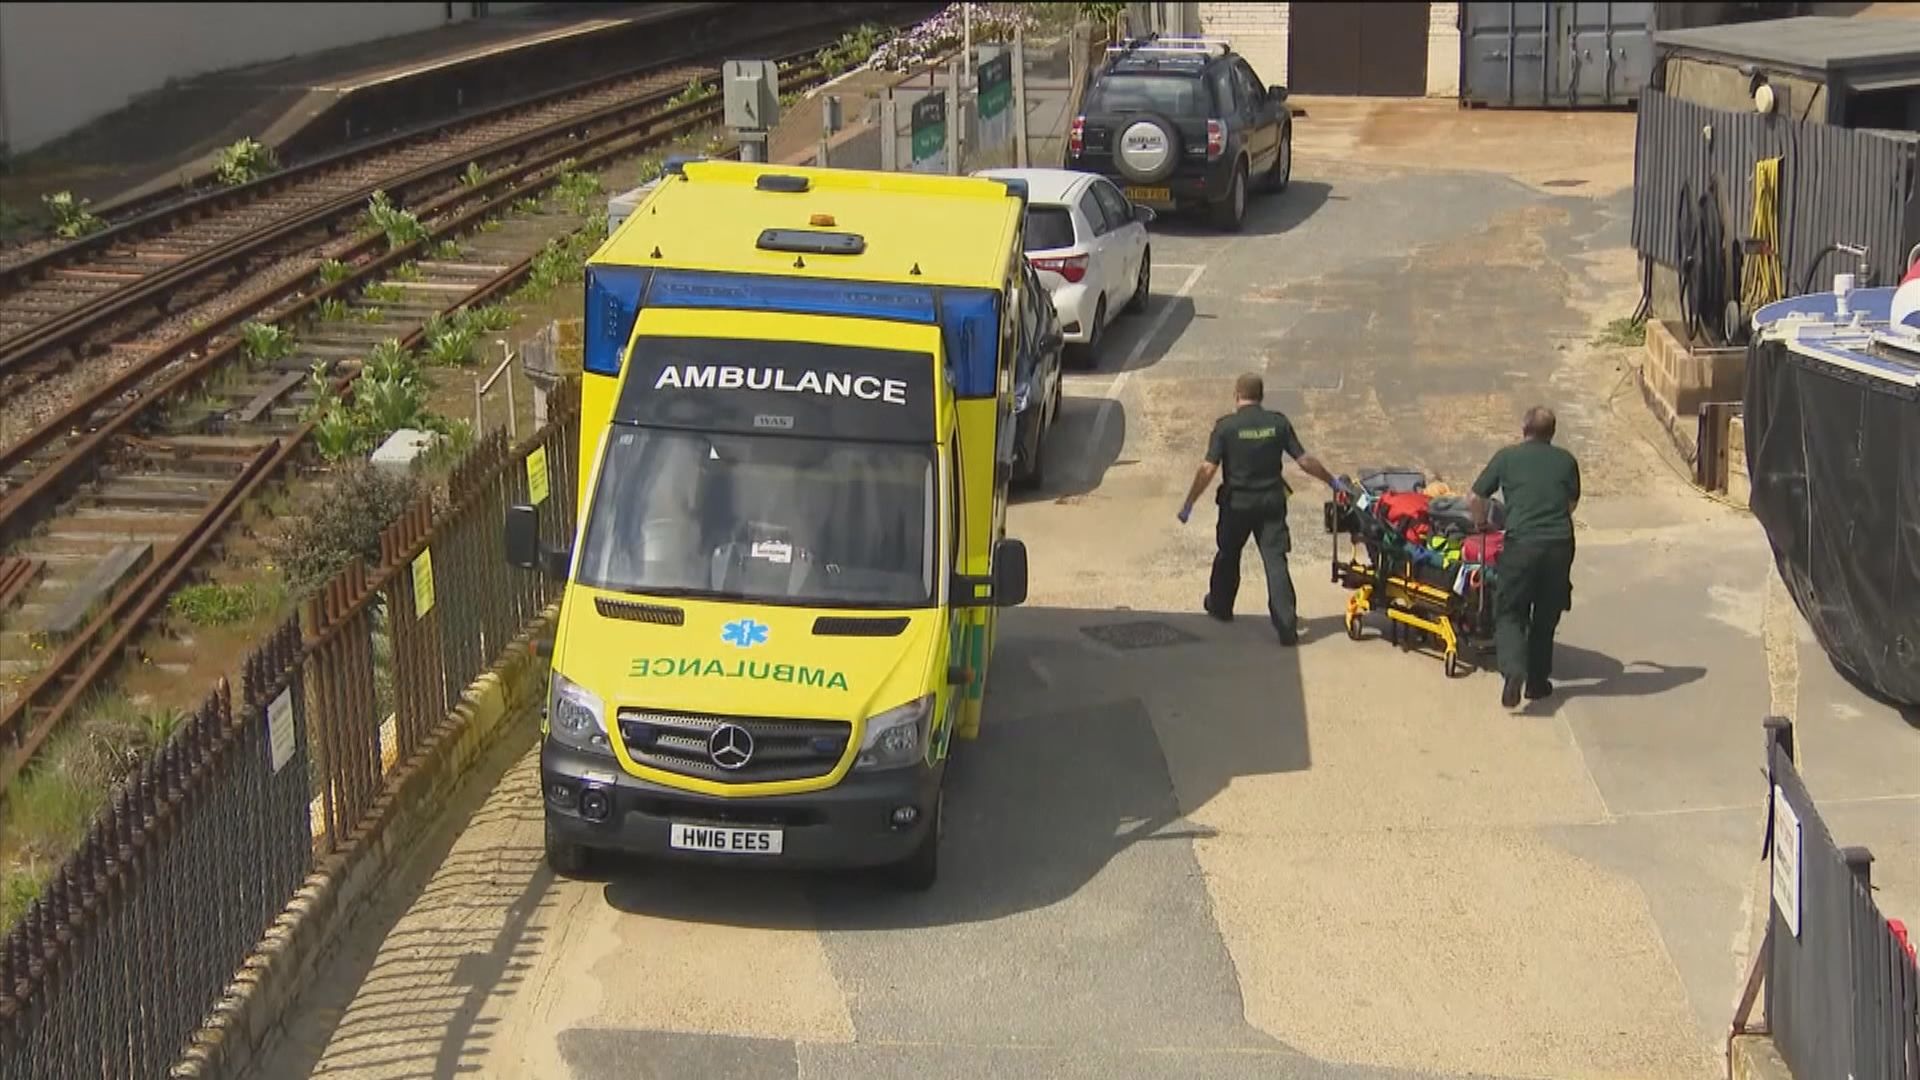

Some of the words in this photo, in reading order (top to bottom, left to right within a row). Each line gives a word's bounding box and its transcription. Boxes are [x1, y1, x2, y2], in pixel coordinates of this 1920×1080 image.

[654, 365, 908, 405] AMBULANCE
[683, 828, 726, 848] HW16
[732, 832, 770, 850] EES
